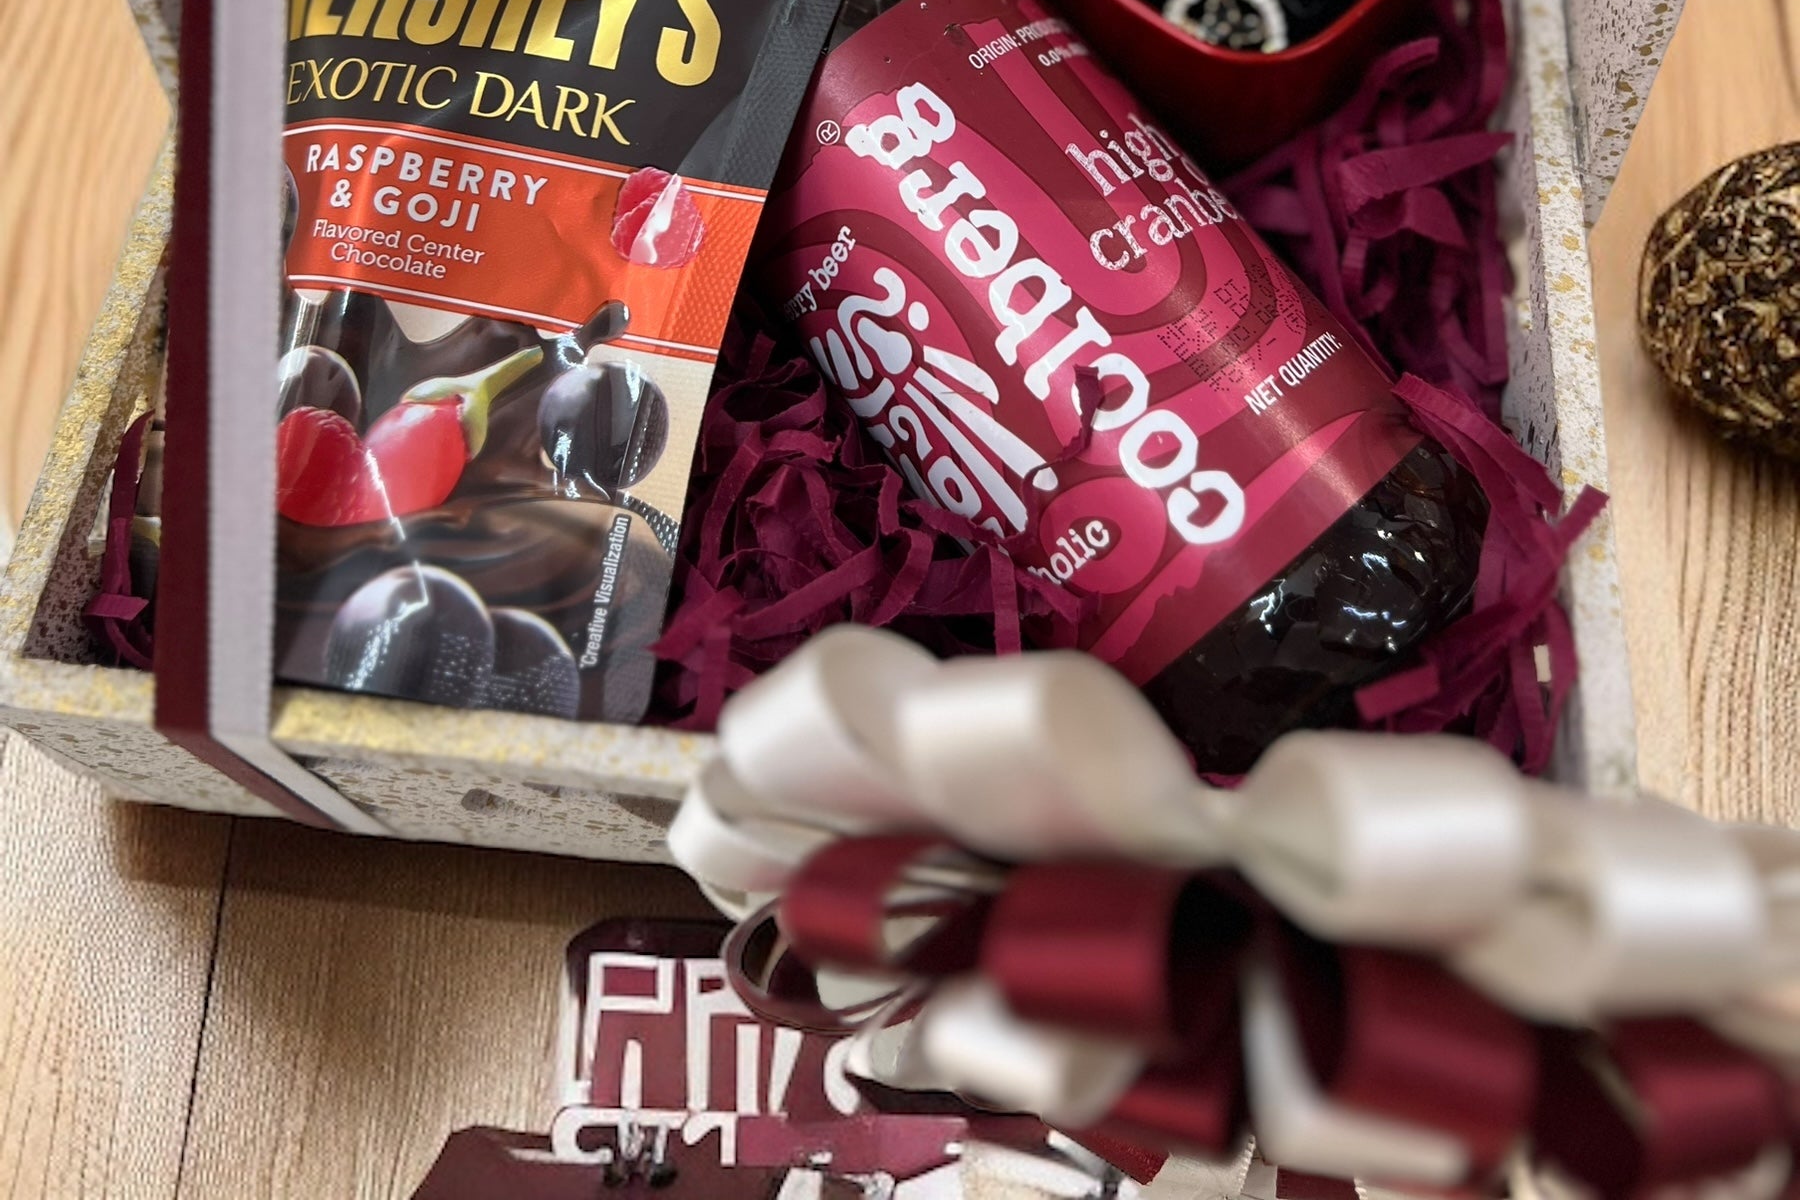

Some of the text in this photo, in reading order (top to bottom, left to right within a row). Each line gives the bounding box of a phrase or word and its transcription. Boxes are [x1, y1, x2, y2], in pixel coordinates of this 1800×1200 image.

[968, 33, 1022, 70] ORIGIN:
[286, 56, 637, 147] EXOTIC DARK
[305, 143, 549, 206] RASPBERRY
[1065, 112, 1181, 197] high
[312, 217, 485, 267] Flavored Center
[329, 179, 480, 233] & GOJI
[1090, 177, 1241, 271] cranbe
[330, 241, 446, 281] Chocolate
[784, 225, 856, 323] erry beer
[1243, 330, 1344, 416] NET QUANTITY:
[594, 516, 629, 604] Visualization
